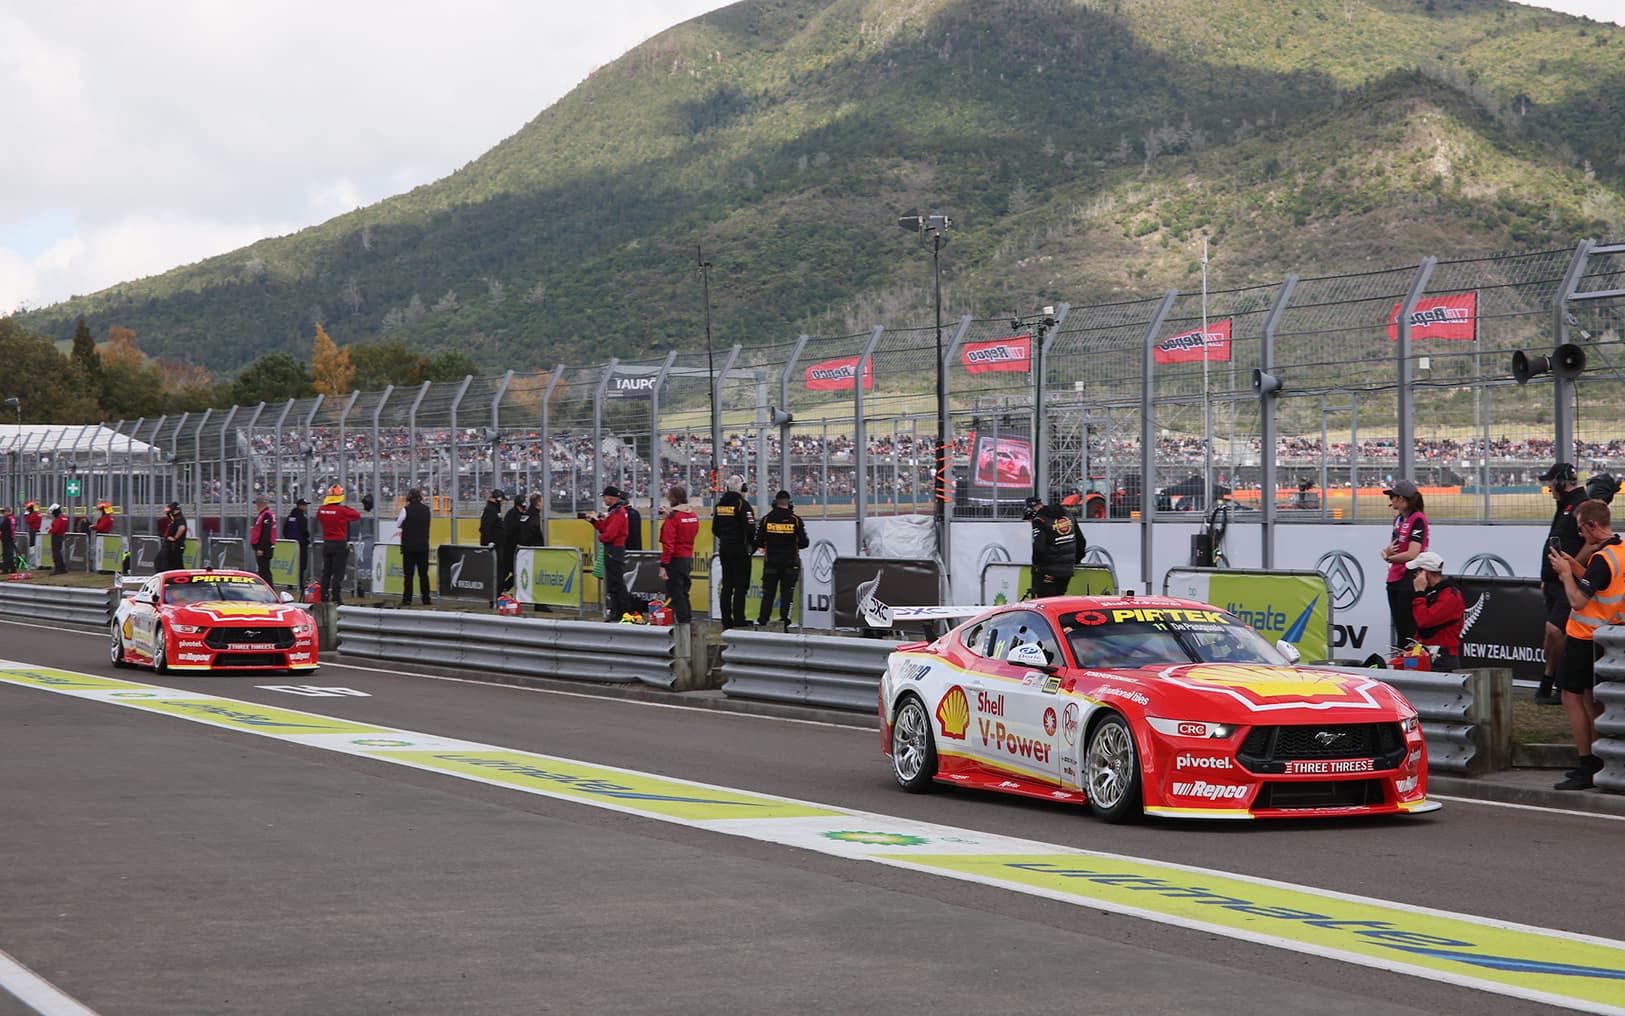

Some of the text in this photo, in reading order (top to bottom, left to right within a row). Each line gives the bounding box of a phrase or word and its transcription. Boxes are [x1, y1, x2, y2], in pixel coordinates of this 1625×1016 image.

[807, 593, 833, 612] LD
[1112, 609, 1230, 625] PIRTEK
[1463, 642, 1487, 658] NEW
[978, 691, 1004, 717] Shell
[978, 717, 1051, 763] V-Power
[1179, 725, 1205, 736] CRC
[1294, 760, 1368, 773] THREE THREES
[1192, 780, 1248, 800] Repco
[1002, 863, 1477, 946] ultimate
